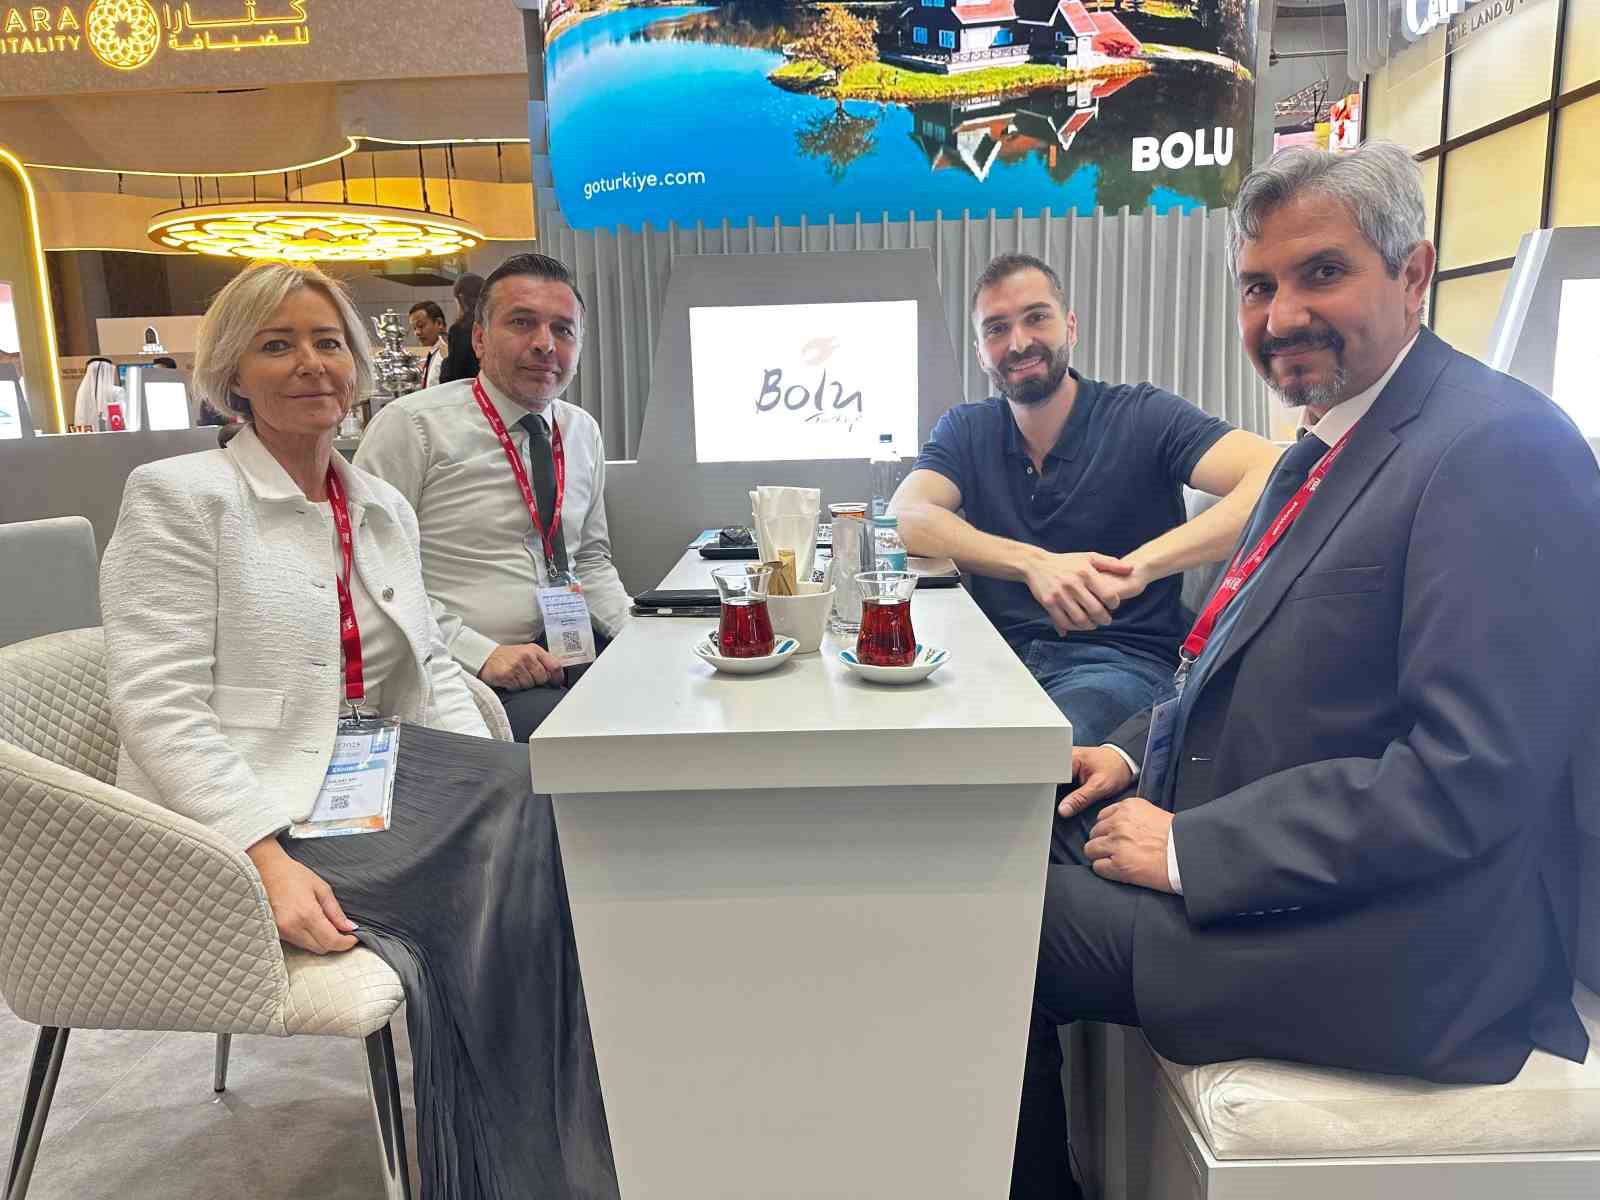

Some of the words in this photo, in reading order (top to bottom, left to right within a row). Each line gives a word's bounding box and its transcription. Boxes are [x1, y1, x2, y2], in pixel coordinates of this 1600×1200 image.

[5, 6, 79, 32] ARA
[1471, 2, 1503, 31] LAND
[1131, 126, 1234, 171] BOLU
[584, 171, 706, 199] goturkiye.com
[755, 367, 862, 414] Bolu
